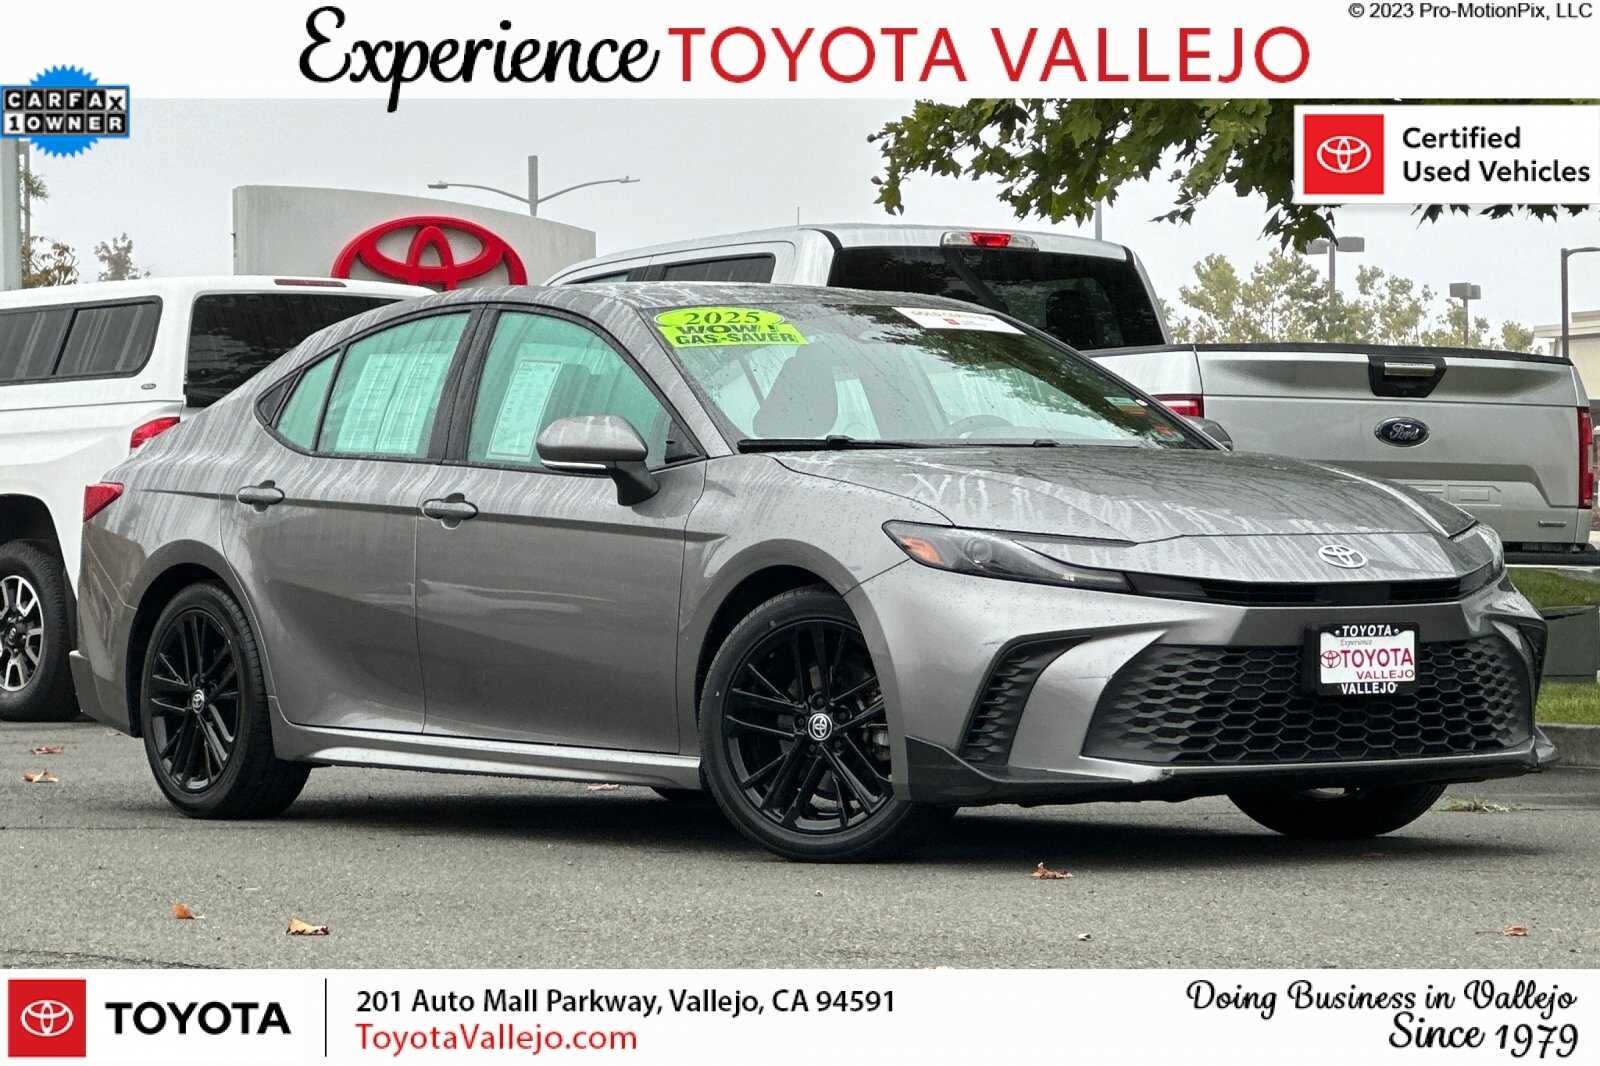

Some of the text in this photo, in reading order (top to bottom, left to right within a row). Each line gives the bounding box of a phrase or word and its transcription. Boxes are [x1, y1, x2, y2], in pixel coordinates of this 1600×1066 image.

[684, 311, 761, 325] 2025
[676, 333, 798, 345] GAS-SAVER
[1389, 423, 1420, 440] Ford
[1342, 624, 1392, 637] TOYOTA
[1340, 648, 1414, 668] TOYOTA
[1356, 669, 1415, 680] VALLEJO
[1341, 681, 1397, 695] VALLEJO
